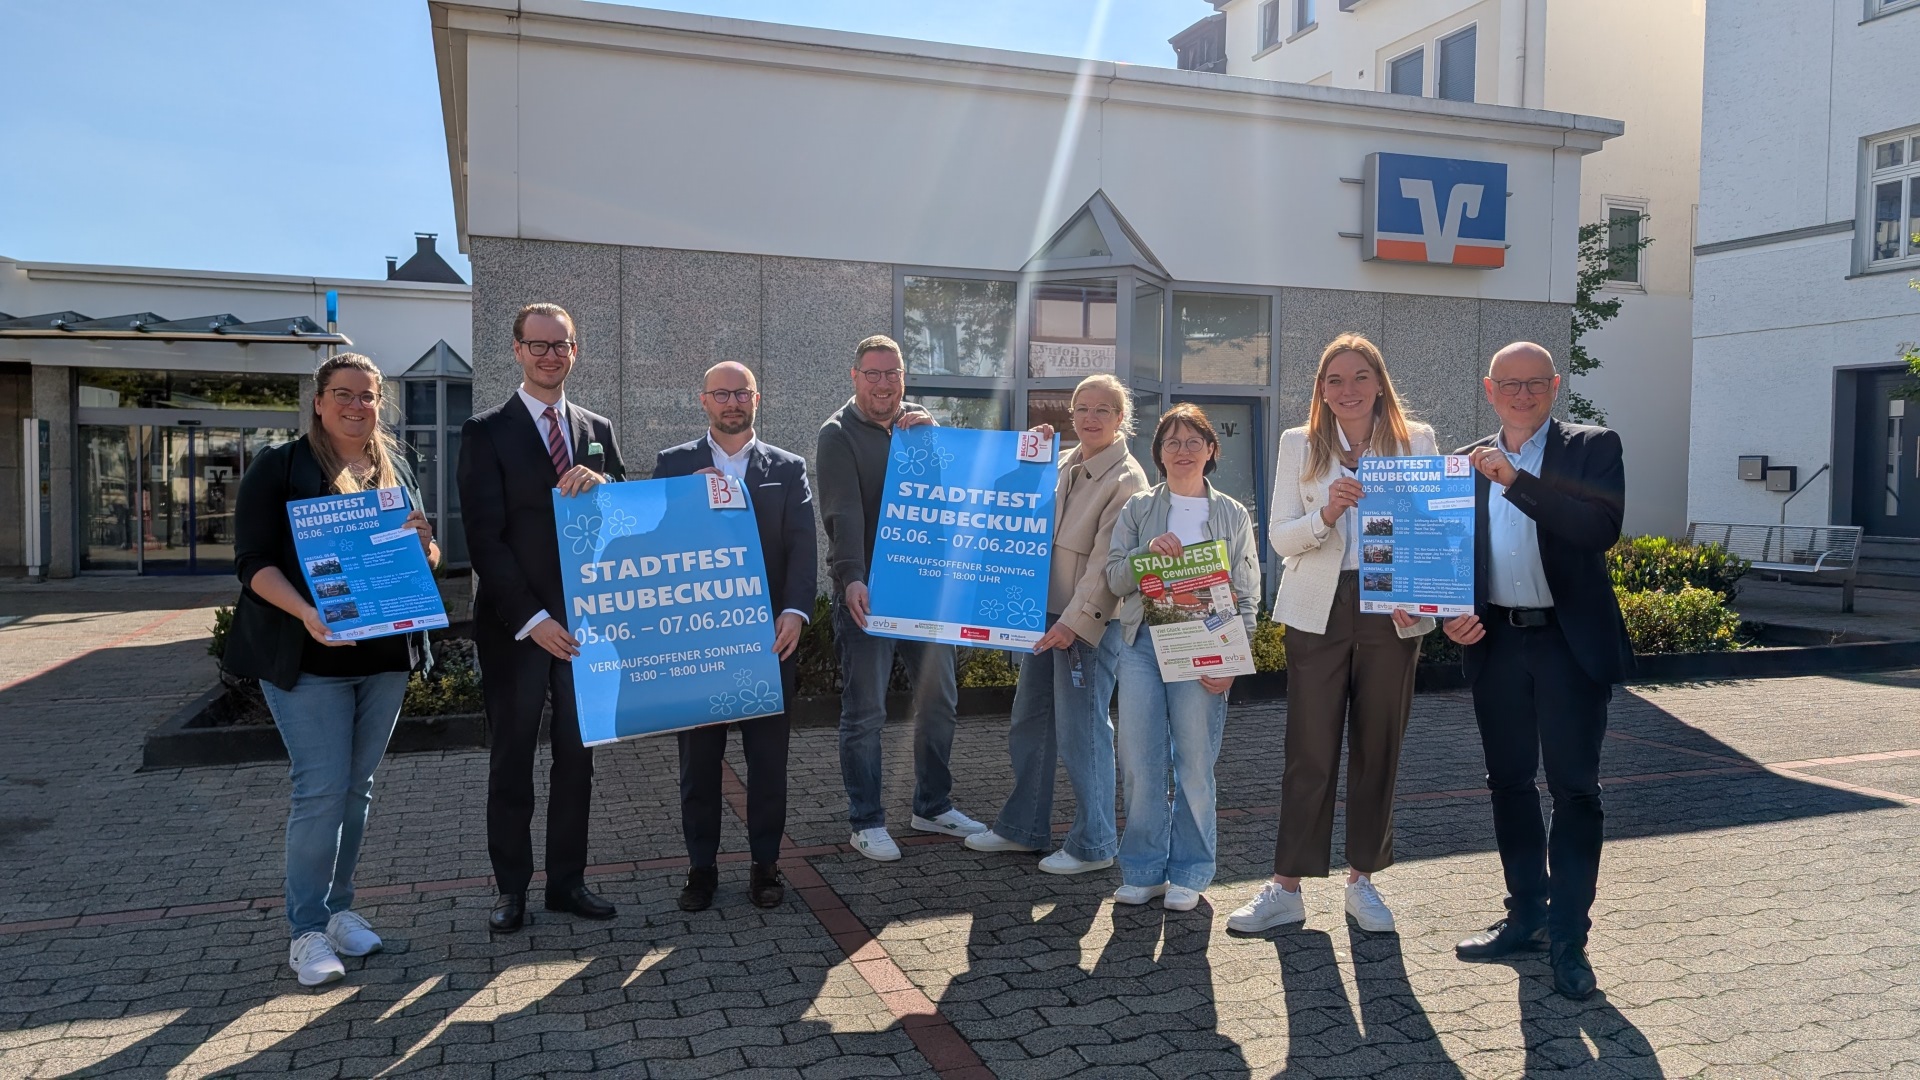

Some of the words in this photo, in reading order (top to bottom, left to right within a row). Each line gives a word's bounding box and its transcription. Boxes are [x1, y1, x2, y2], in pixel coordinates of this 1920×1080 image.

[1362, 459, 1432, 470] STADTFEST
[1362, 471, 1441, 482] NEUBECKUM
[710, 477, 720, 504] BECKUM
[898, 481, 1041, 509] STADTFEST
[1362, 485, 1387, 493] 05.06.
[1395, 484, 1441, 493] 07.06.2026
[292, 496, 366, 517] STADTFEST
[295, 507, 378, 529] NEUBECKUM
[886, 503, 1047, 534] NEUBECKUM
[297, 528, 325, 540] 05.06.
[333, 519, 380, 535] 07.06.2026
[880, 526, 932, 545] 05.06.
[952, 534, 1048, 557] 07.06.2026
[580, 546, 748, 584] STADTFEST
[886, 554, 988, 571] VERKAUFSOFFENER
[985, 564, 1035, 577] SONNTAG
[1162, 560, 1225, 579] Gewinnspiel
[918, 568, 941, 578] 13:00
[952, 572, 976, 582] 18:00
[978, 574, 1001, 584] UHR
[573, 576, 762, 617] NEUBECKUM
[574, 621, 636, 647] 05.06.
[659, 606, 769, 635] 07.06.2026
[873, 619, 890, 628] evb
[589, 649, 701, 673] VERKAUFSOFFENER
[704, 642, 762, 658] SONNTAG
[1224, 653, 1239, 662] evb
[629, 670, 657, 682] 13:00
[669, 665, 697, 678] 18:00
[700, 661, 726, 673] UHR
